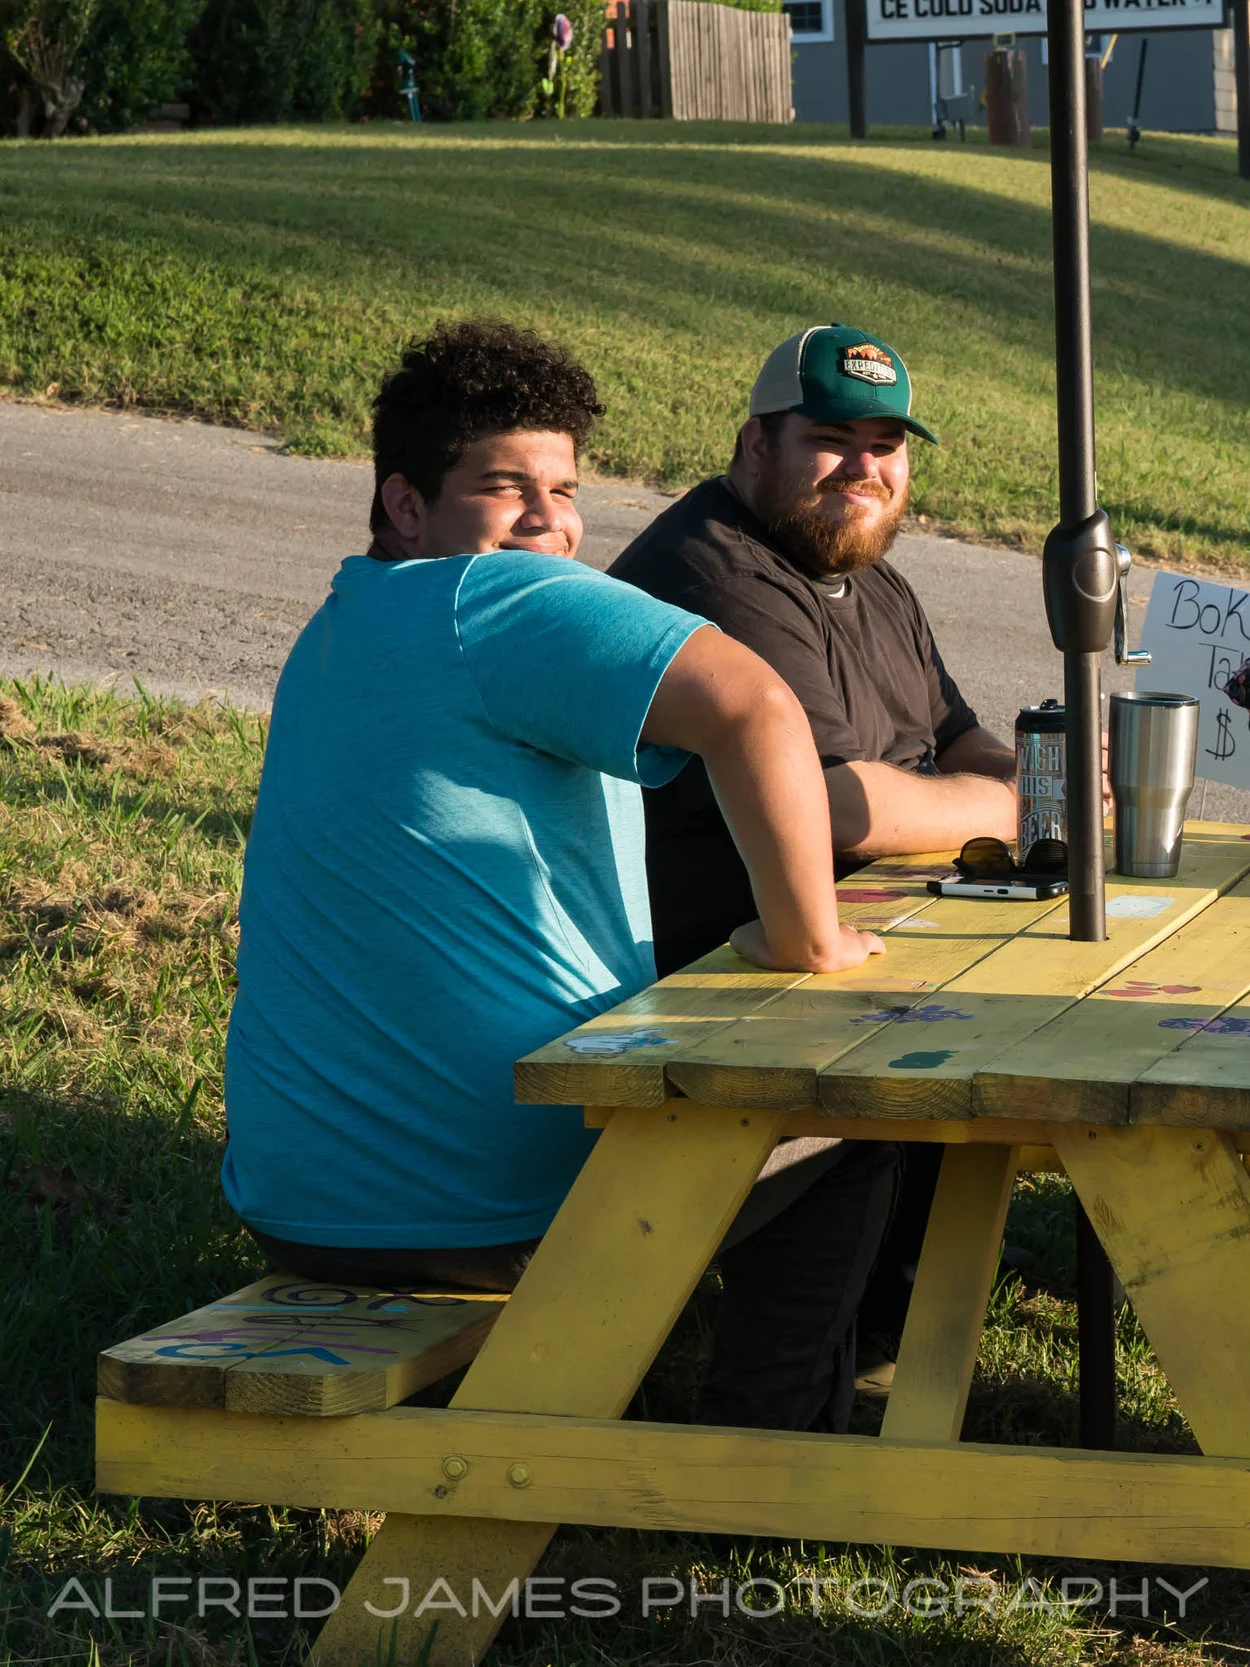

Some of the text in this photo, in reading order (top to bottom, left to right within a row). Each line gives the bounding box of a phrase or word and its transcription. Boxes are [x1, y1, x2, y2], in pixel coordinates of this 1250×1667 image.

[915, 0, 973, 17] COLD
[980, 0, 1042, 14] SODA
[1020, 810, 1062, 851] BEER
